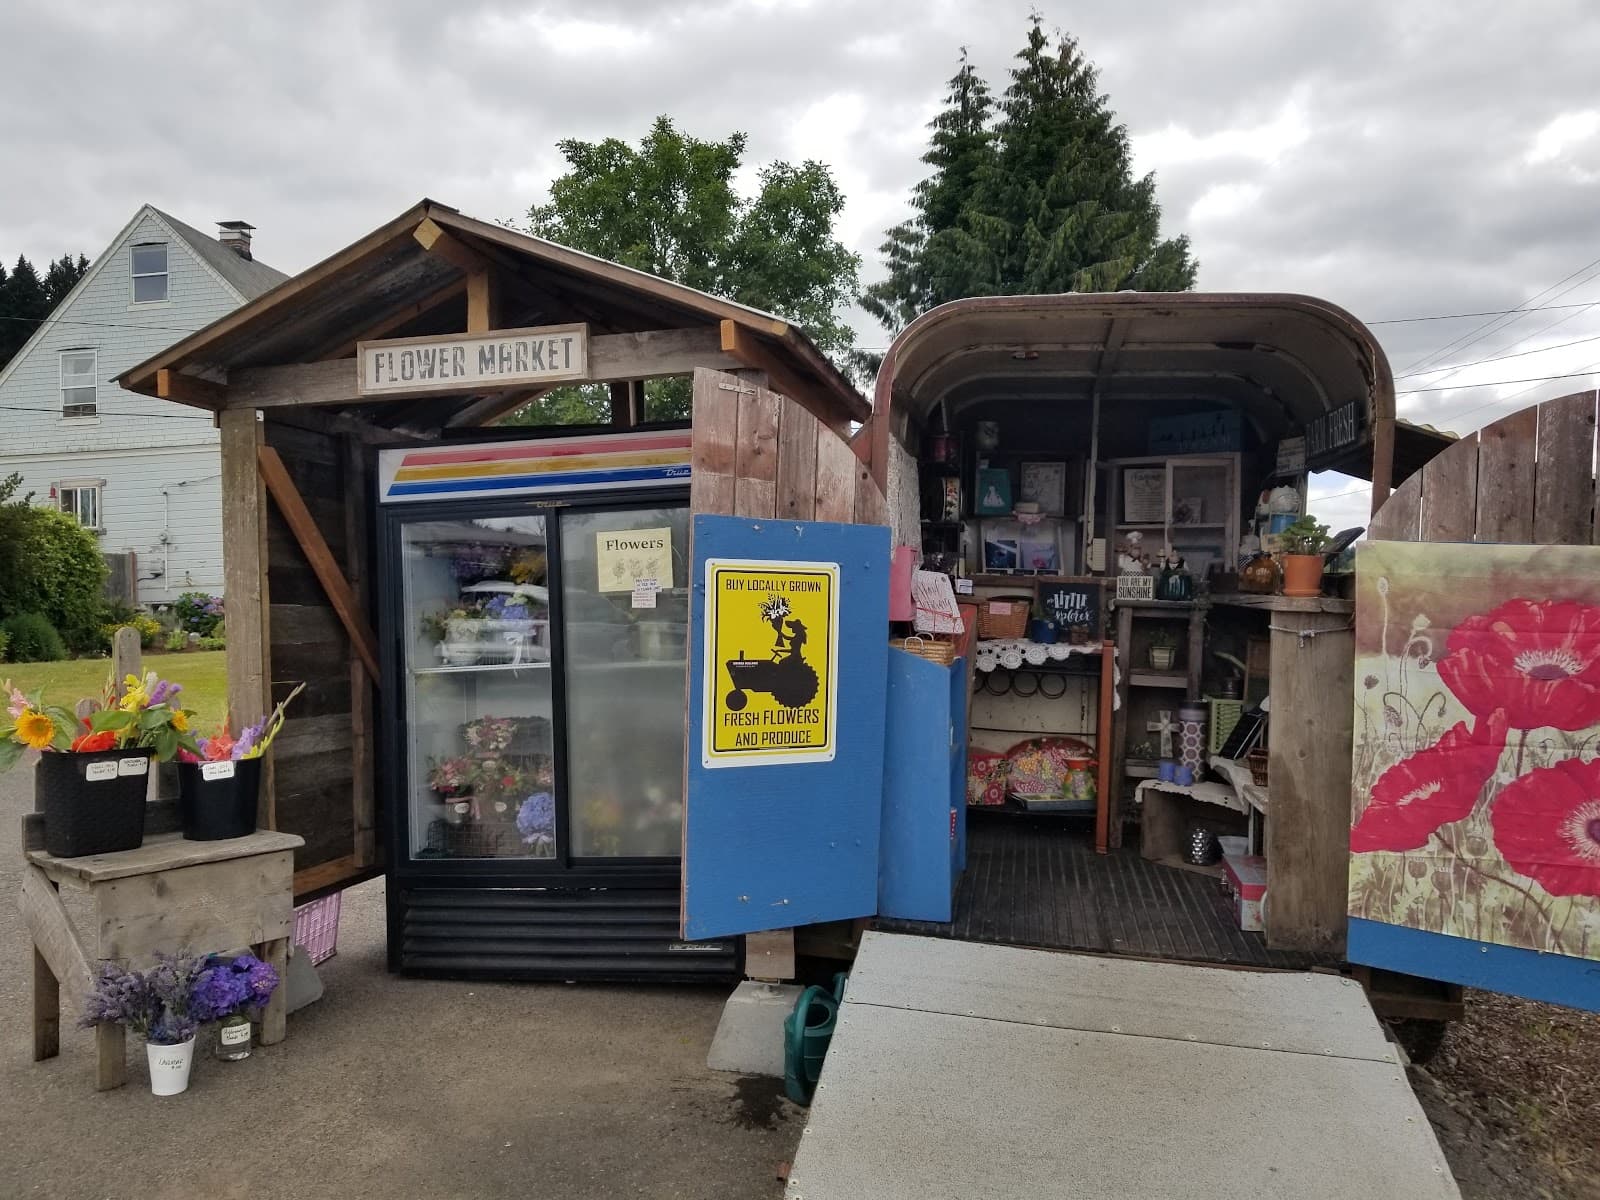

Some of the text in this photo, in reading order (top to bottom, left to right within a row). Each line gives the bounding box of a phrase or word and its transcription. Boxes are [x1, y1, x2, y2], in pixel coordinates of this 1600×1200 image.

[375, 337, 573, 383] FLOWER MARKET
[1328, 401, 1355, 449] FRESH
[605, 537, 665, 552] Flowers
[725, 579, 822, 593] BUY LOCALLY GROWN
[1118, 576, 1152, 587] YOU ARE MY
[1118, 586, 1152, 599] SUNSHINE
[724, 708, 820, 727] FRESH FLOWERS
[735, 729, 812, 747] AND PRODUCE
